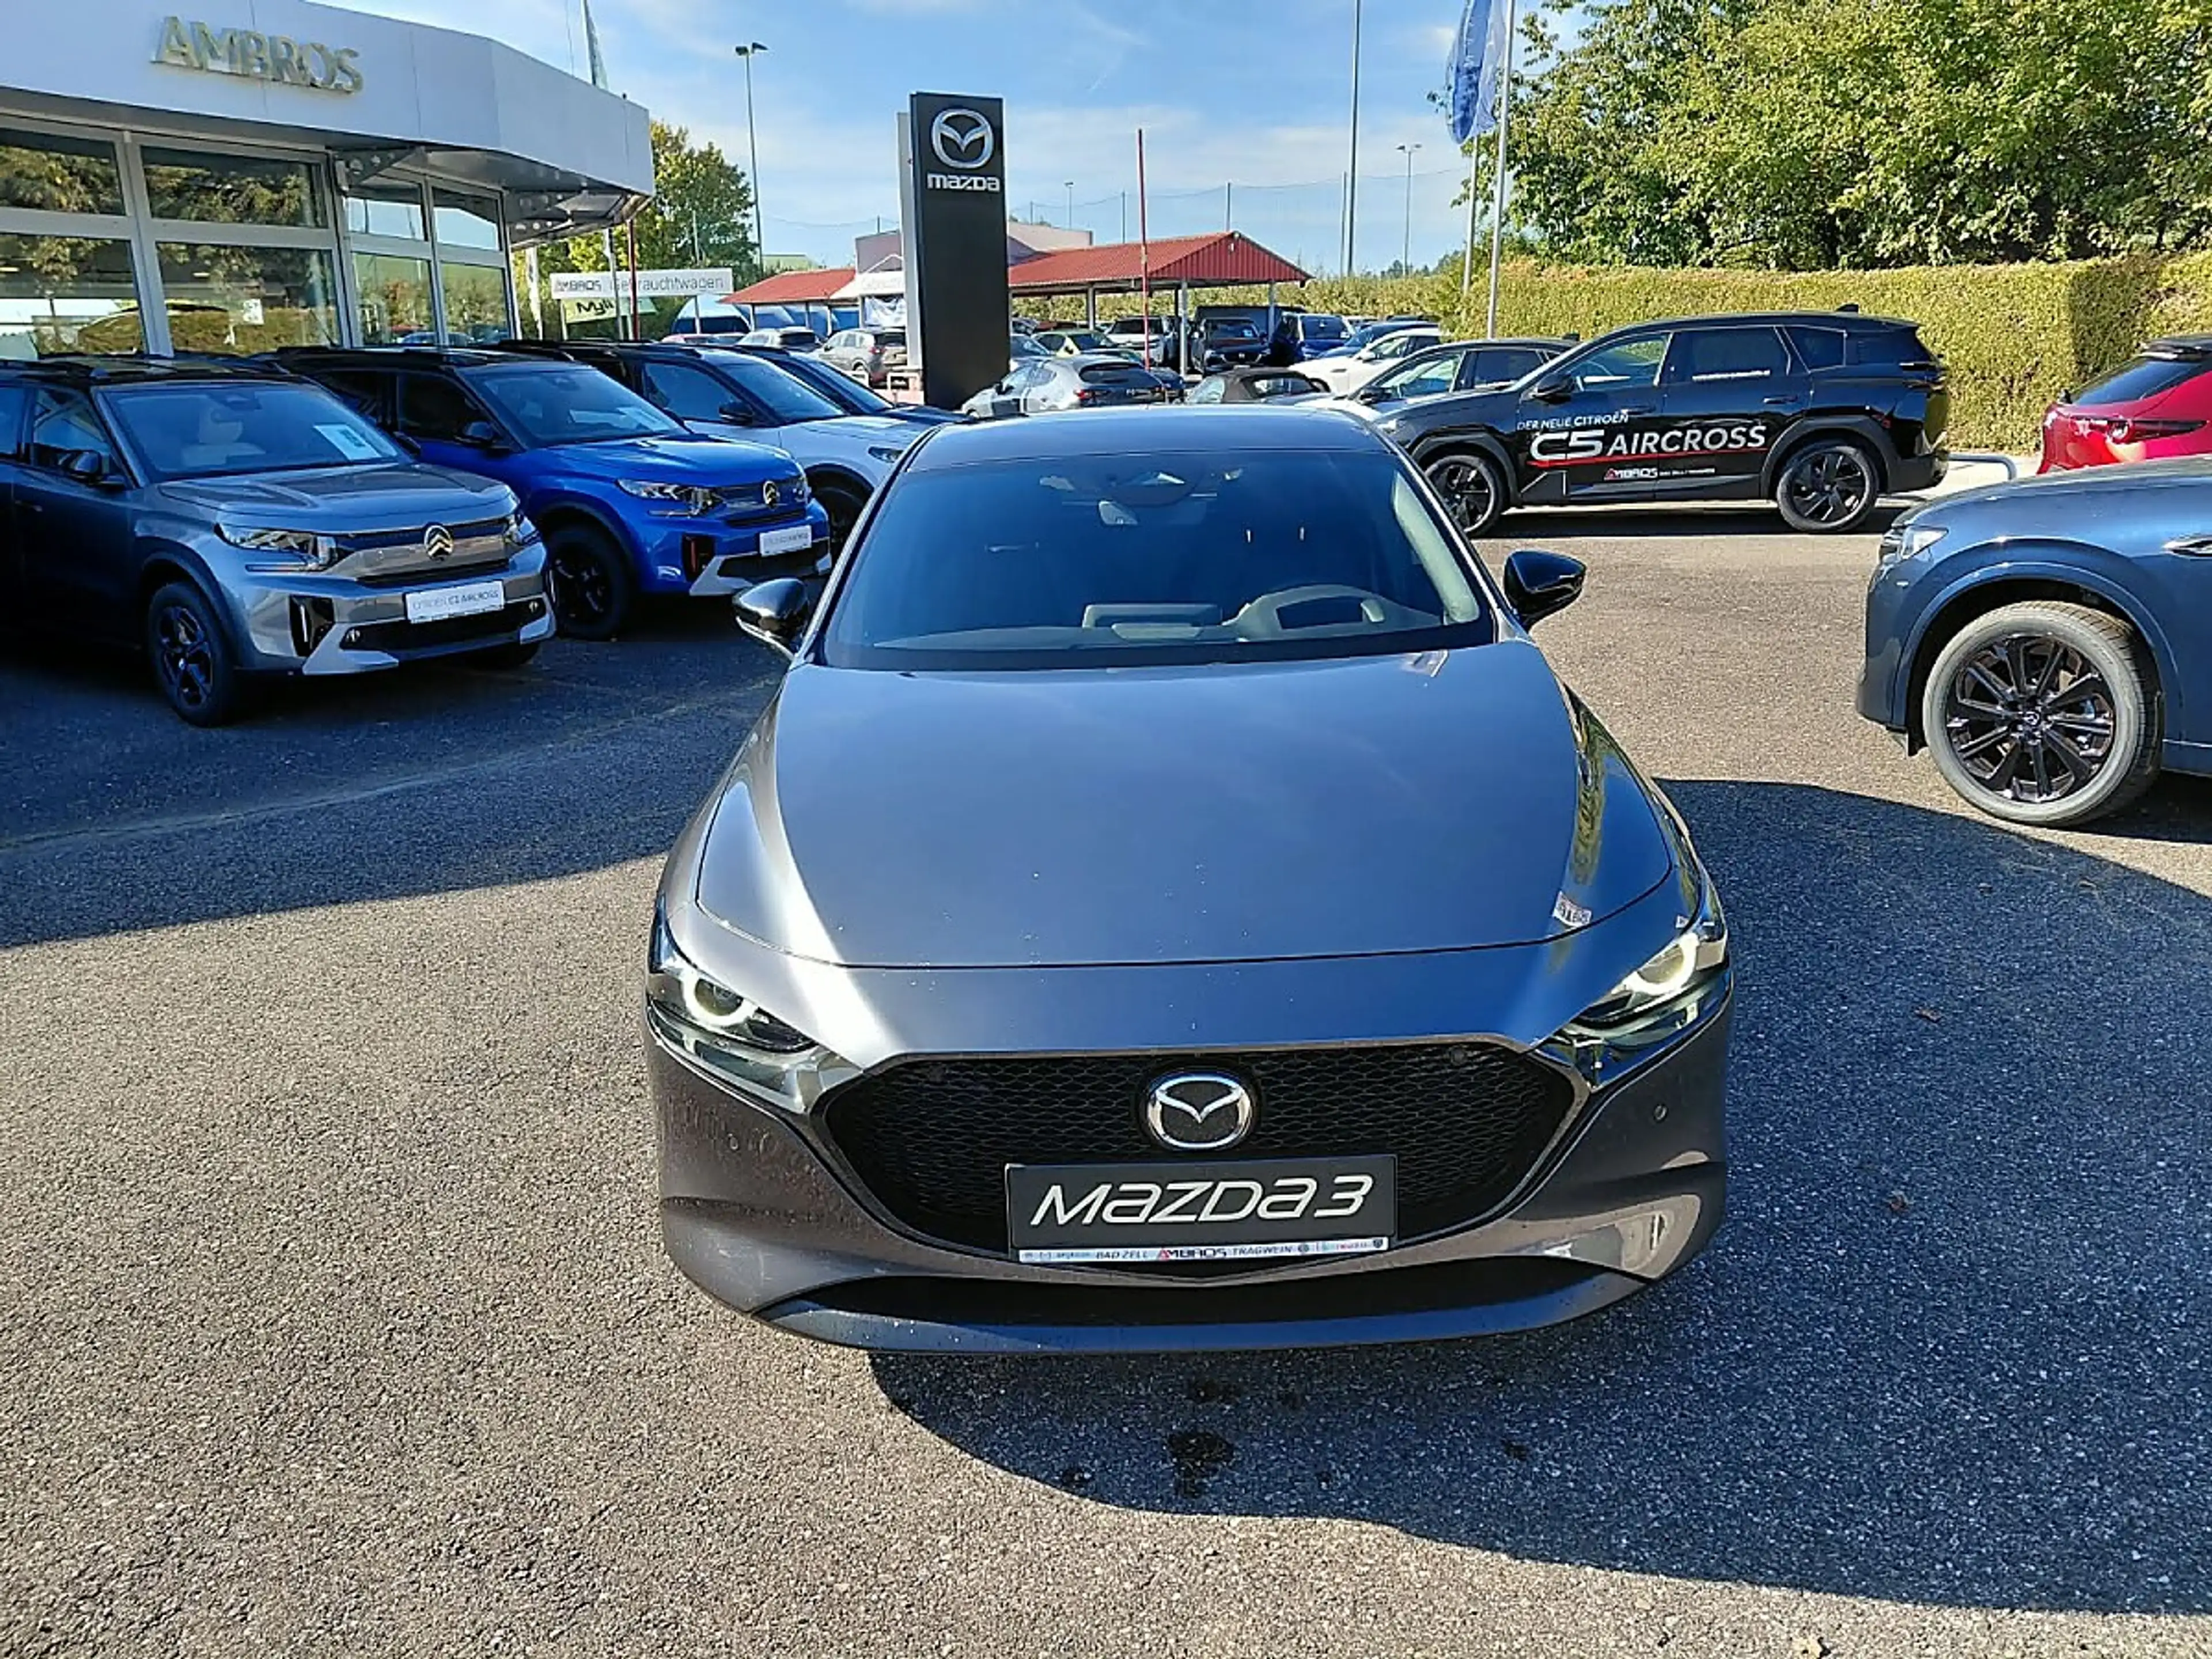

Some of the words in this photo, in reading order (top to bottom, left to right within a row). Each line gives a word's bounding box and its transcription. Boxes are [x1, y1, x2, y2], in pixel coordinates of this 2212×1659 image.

[151, 16, 363, 93] AMBROS
[1517, 420, 1539, 430] DER
[1541, 417, 1572, 429] NEUE
[1530, 429, 1605, 460] C5
[1606, 425, 1767, 456] AIRCROSS
[1157, 1248, 1227, 1260] AMBROS
[1232, 1245, 1293, 1256] TRAGWEIN
